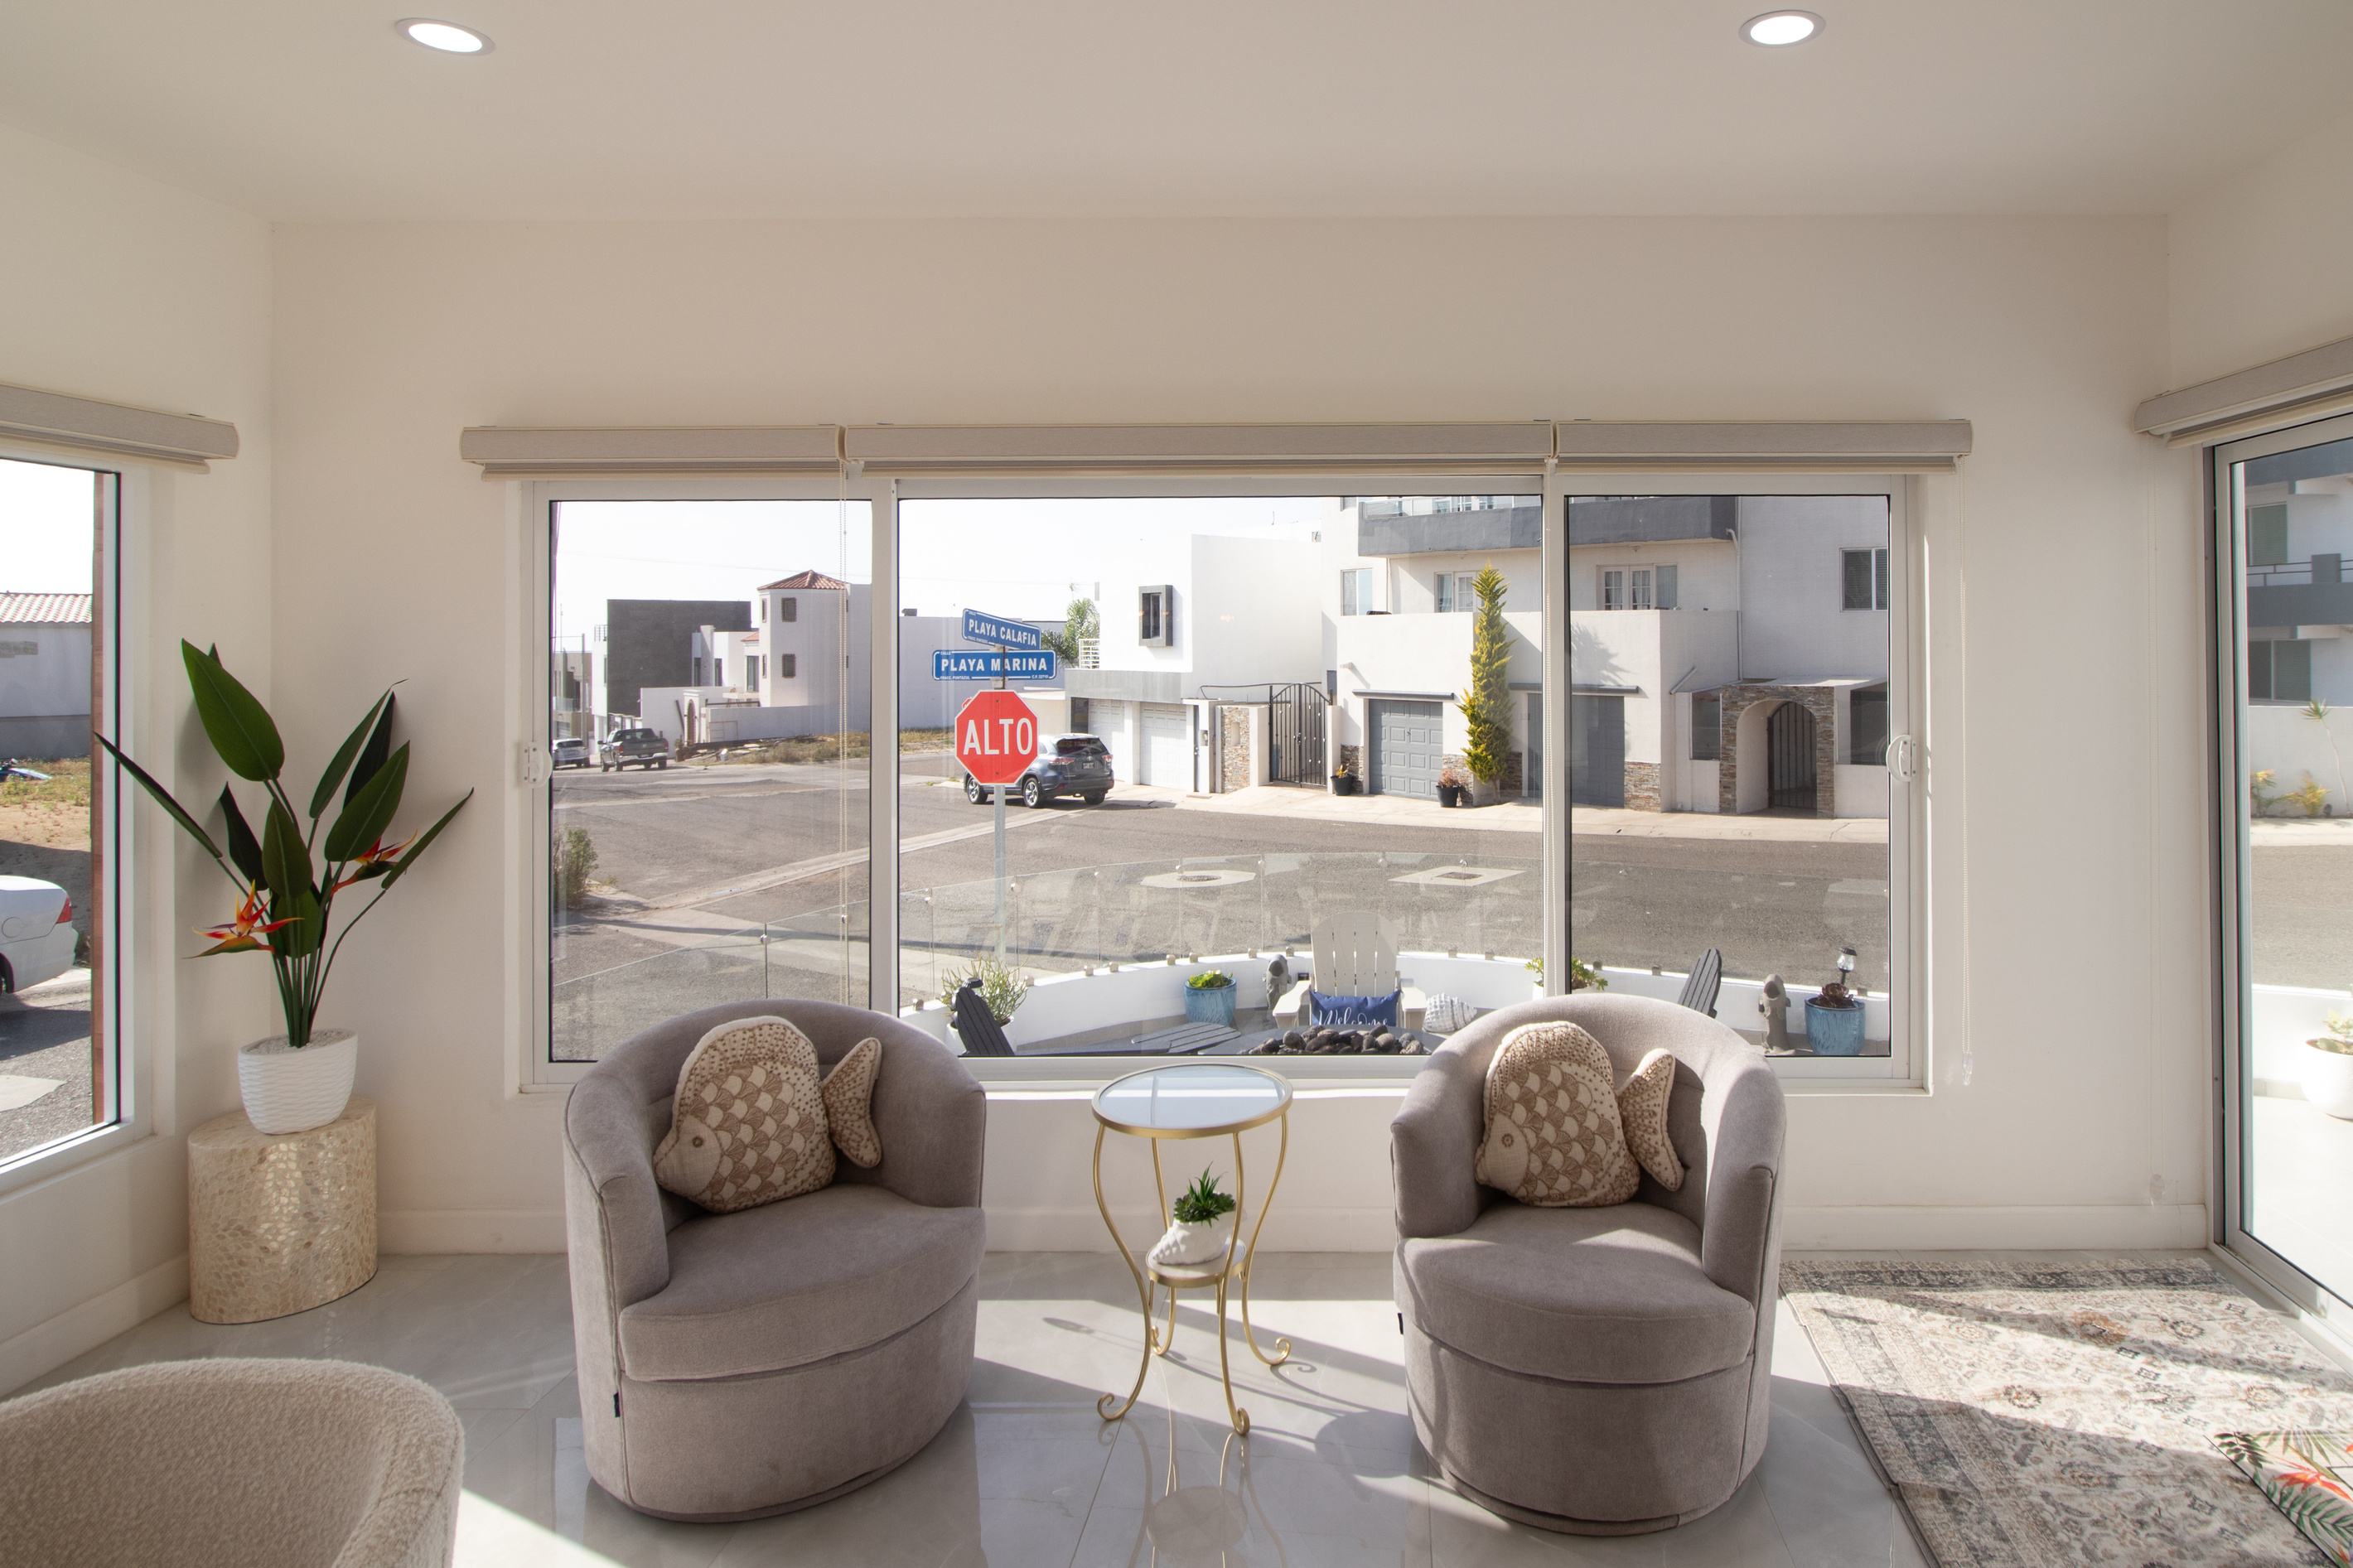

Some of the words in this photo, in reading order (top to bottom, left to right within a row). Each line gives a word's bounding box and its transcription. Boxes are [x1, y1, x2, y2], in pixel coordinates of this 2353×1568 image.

[969, 619, 997, 637] PLAYA
[1000, 627, 1036, 646] CALAFIA
[941, 659, 985, 671] PLAYA
[991, 658, 1047, 671] MARINA
[963, 718, 1033, 755] ALTO
